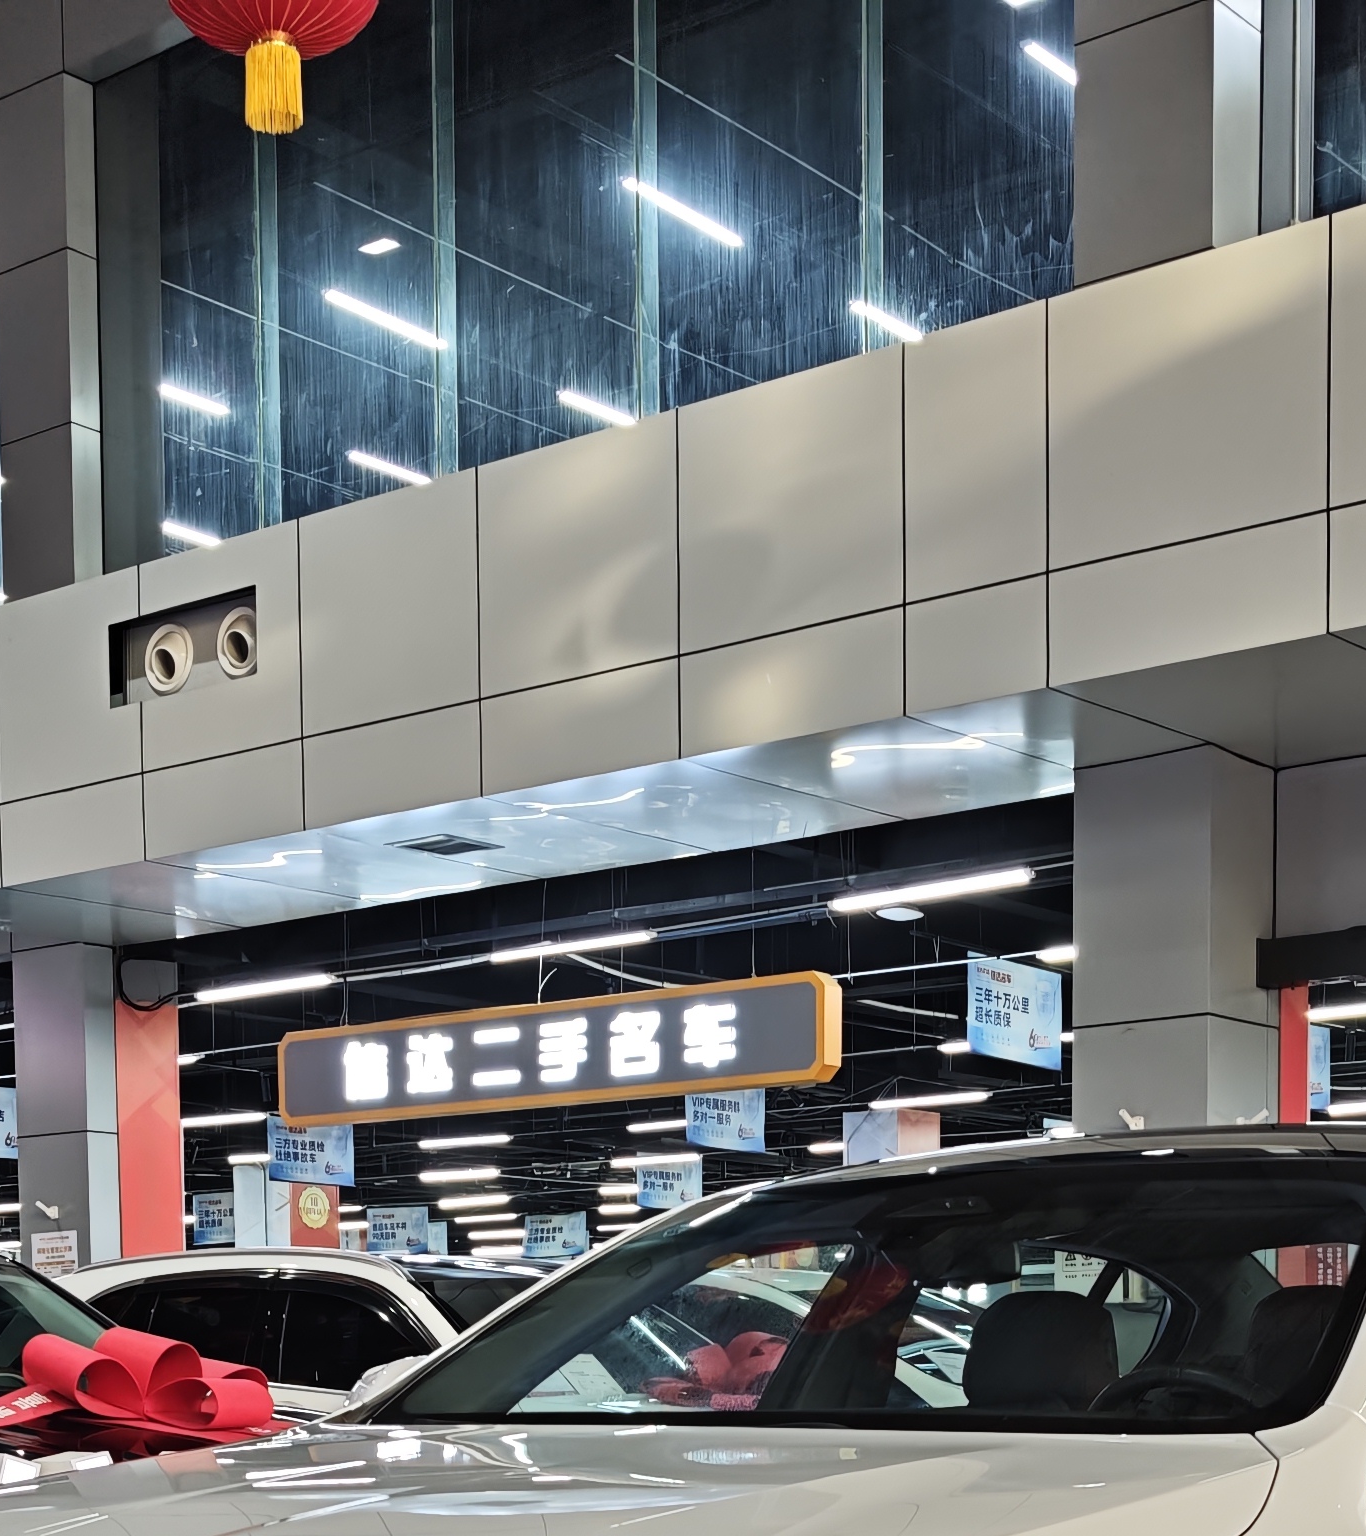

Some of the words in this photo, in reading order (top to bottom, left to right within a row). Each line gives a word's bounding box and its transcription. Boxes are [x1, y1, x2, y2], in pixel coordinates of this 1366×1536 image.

[975, 987, 1030, 1014] 三年十万公里
[975, 1006, 1011, 1028] 超长质保
[343, 1003, 739, 1102] 信达二手名车
[692, 1110, 732, 1127] 多对一服务
[275, 1137, 325, 1153] 三方专业质检
[275, 1151, 317, 1164] 杜绝事故车
